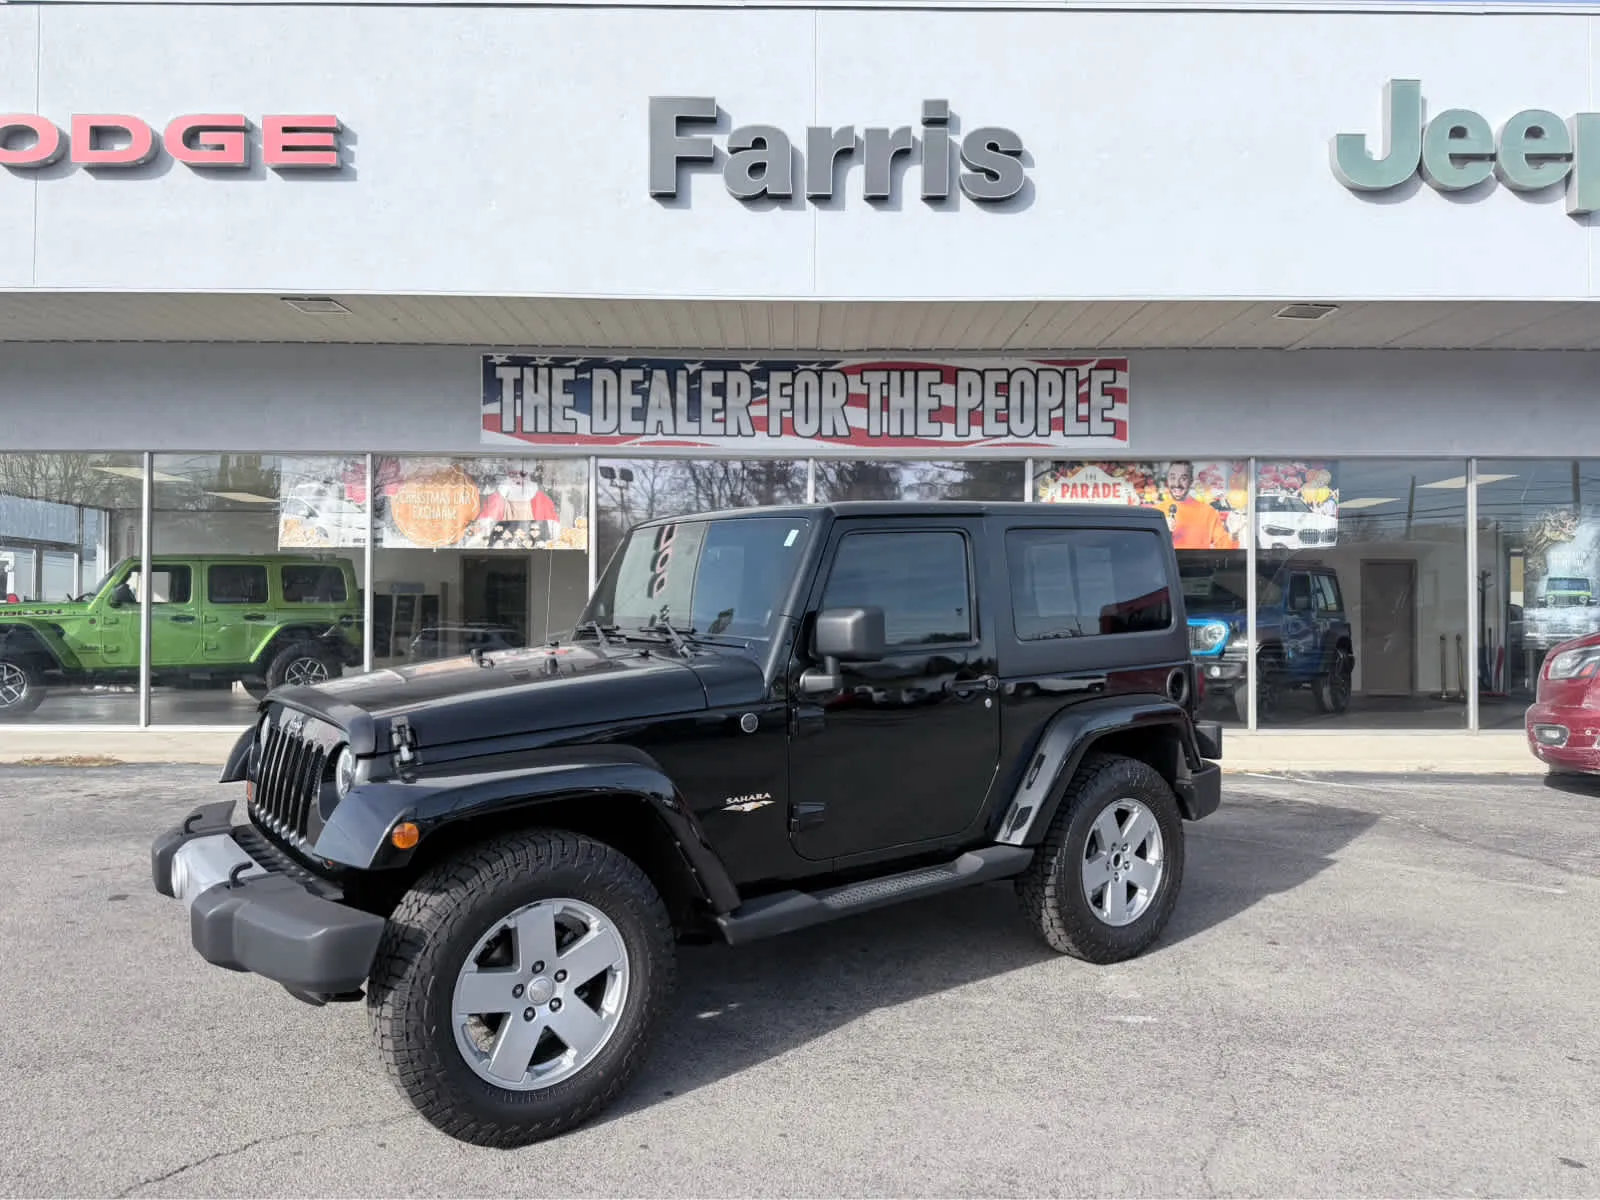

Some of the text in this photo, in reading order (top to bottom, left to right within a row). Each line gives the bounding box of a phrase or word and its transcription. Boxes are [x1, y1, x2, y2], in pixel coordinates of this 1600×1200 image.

[648, 95, 1026, 200] Farris
[495, 364, 1118, 438] THE DEALER FOR THE PEOPLE
[1061, 482, 1122, 499] PARADE
[726, 792, 771, 804] SAHARA
